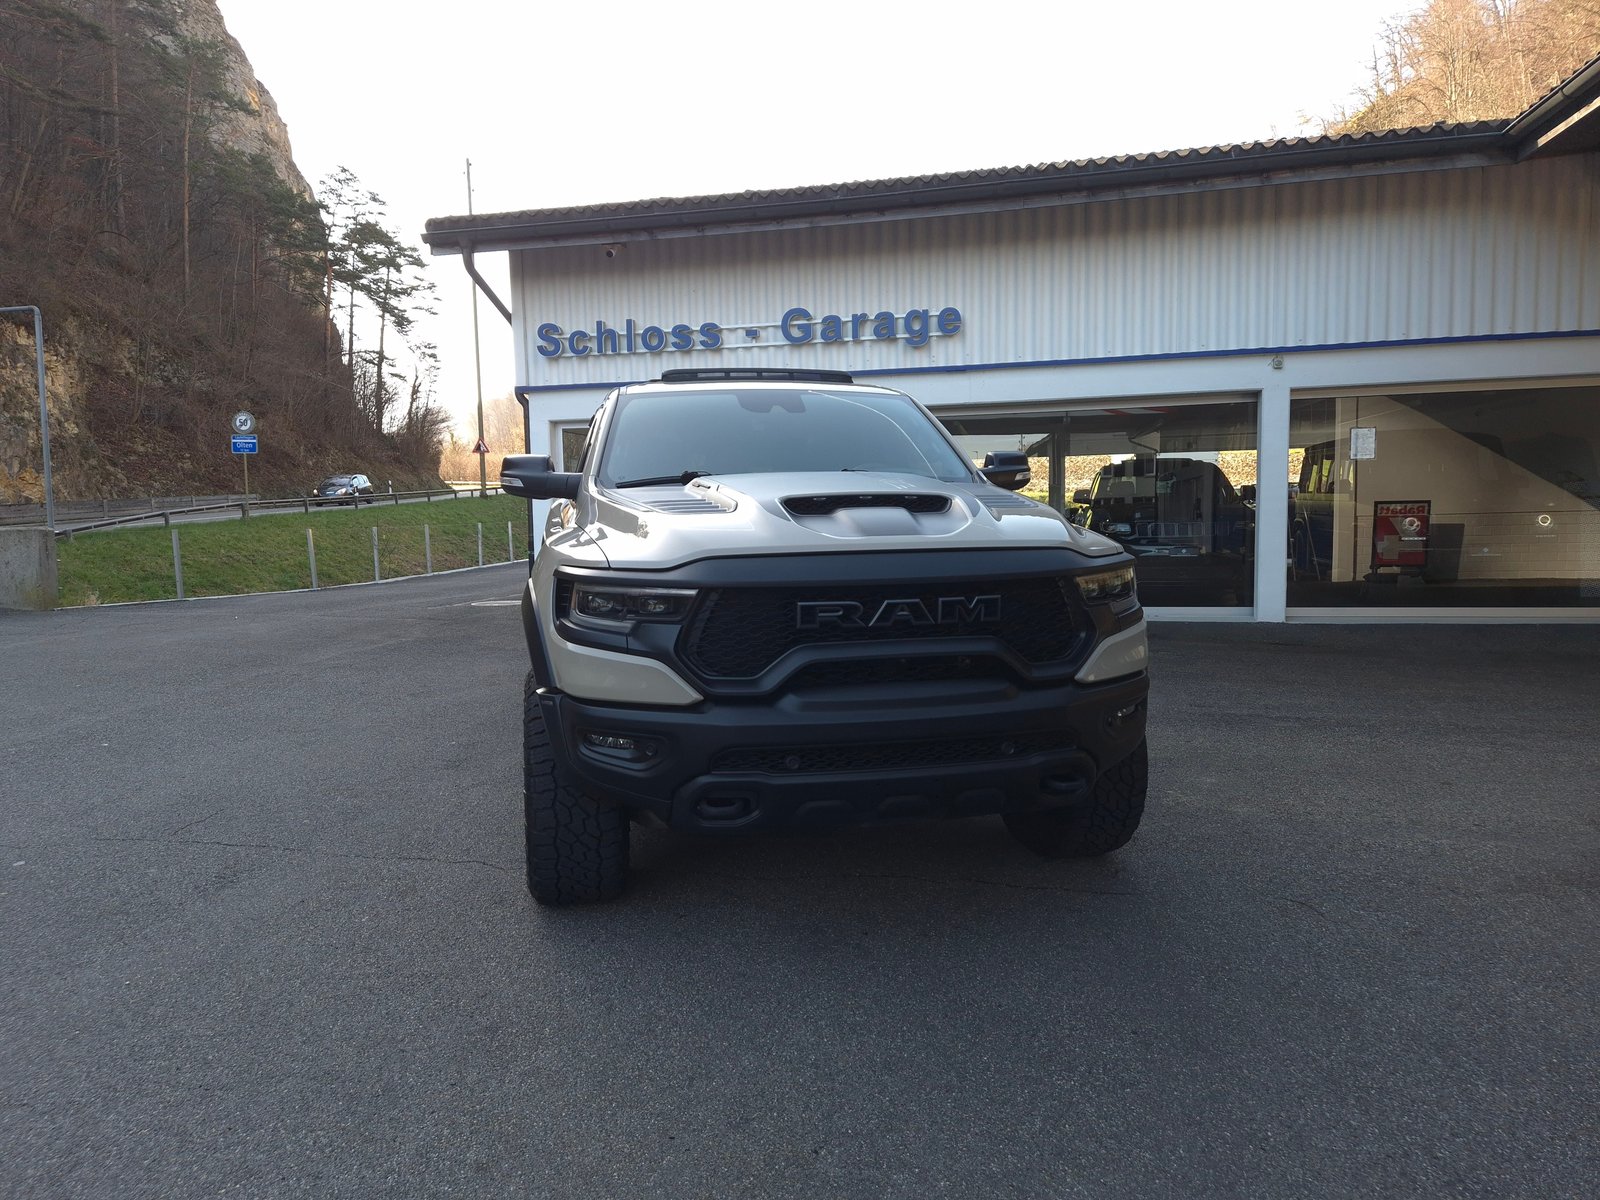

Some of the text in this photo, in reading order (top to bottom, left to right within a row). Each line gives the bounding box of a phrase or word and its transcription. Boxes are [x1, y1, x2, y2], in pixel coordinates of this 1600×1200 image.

[537, 318, 723, 358] Schloss
[780, 306, 962, 347] Garage
[239, 418, 248, 427] 50
[796, 594, 1001, 629] RAM
